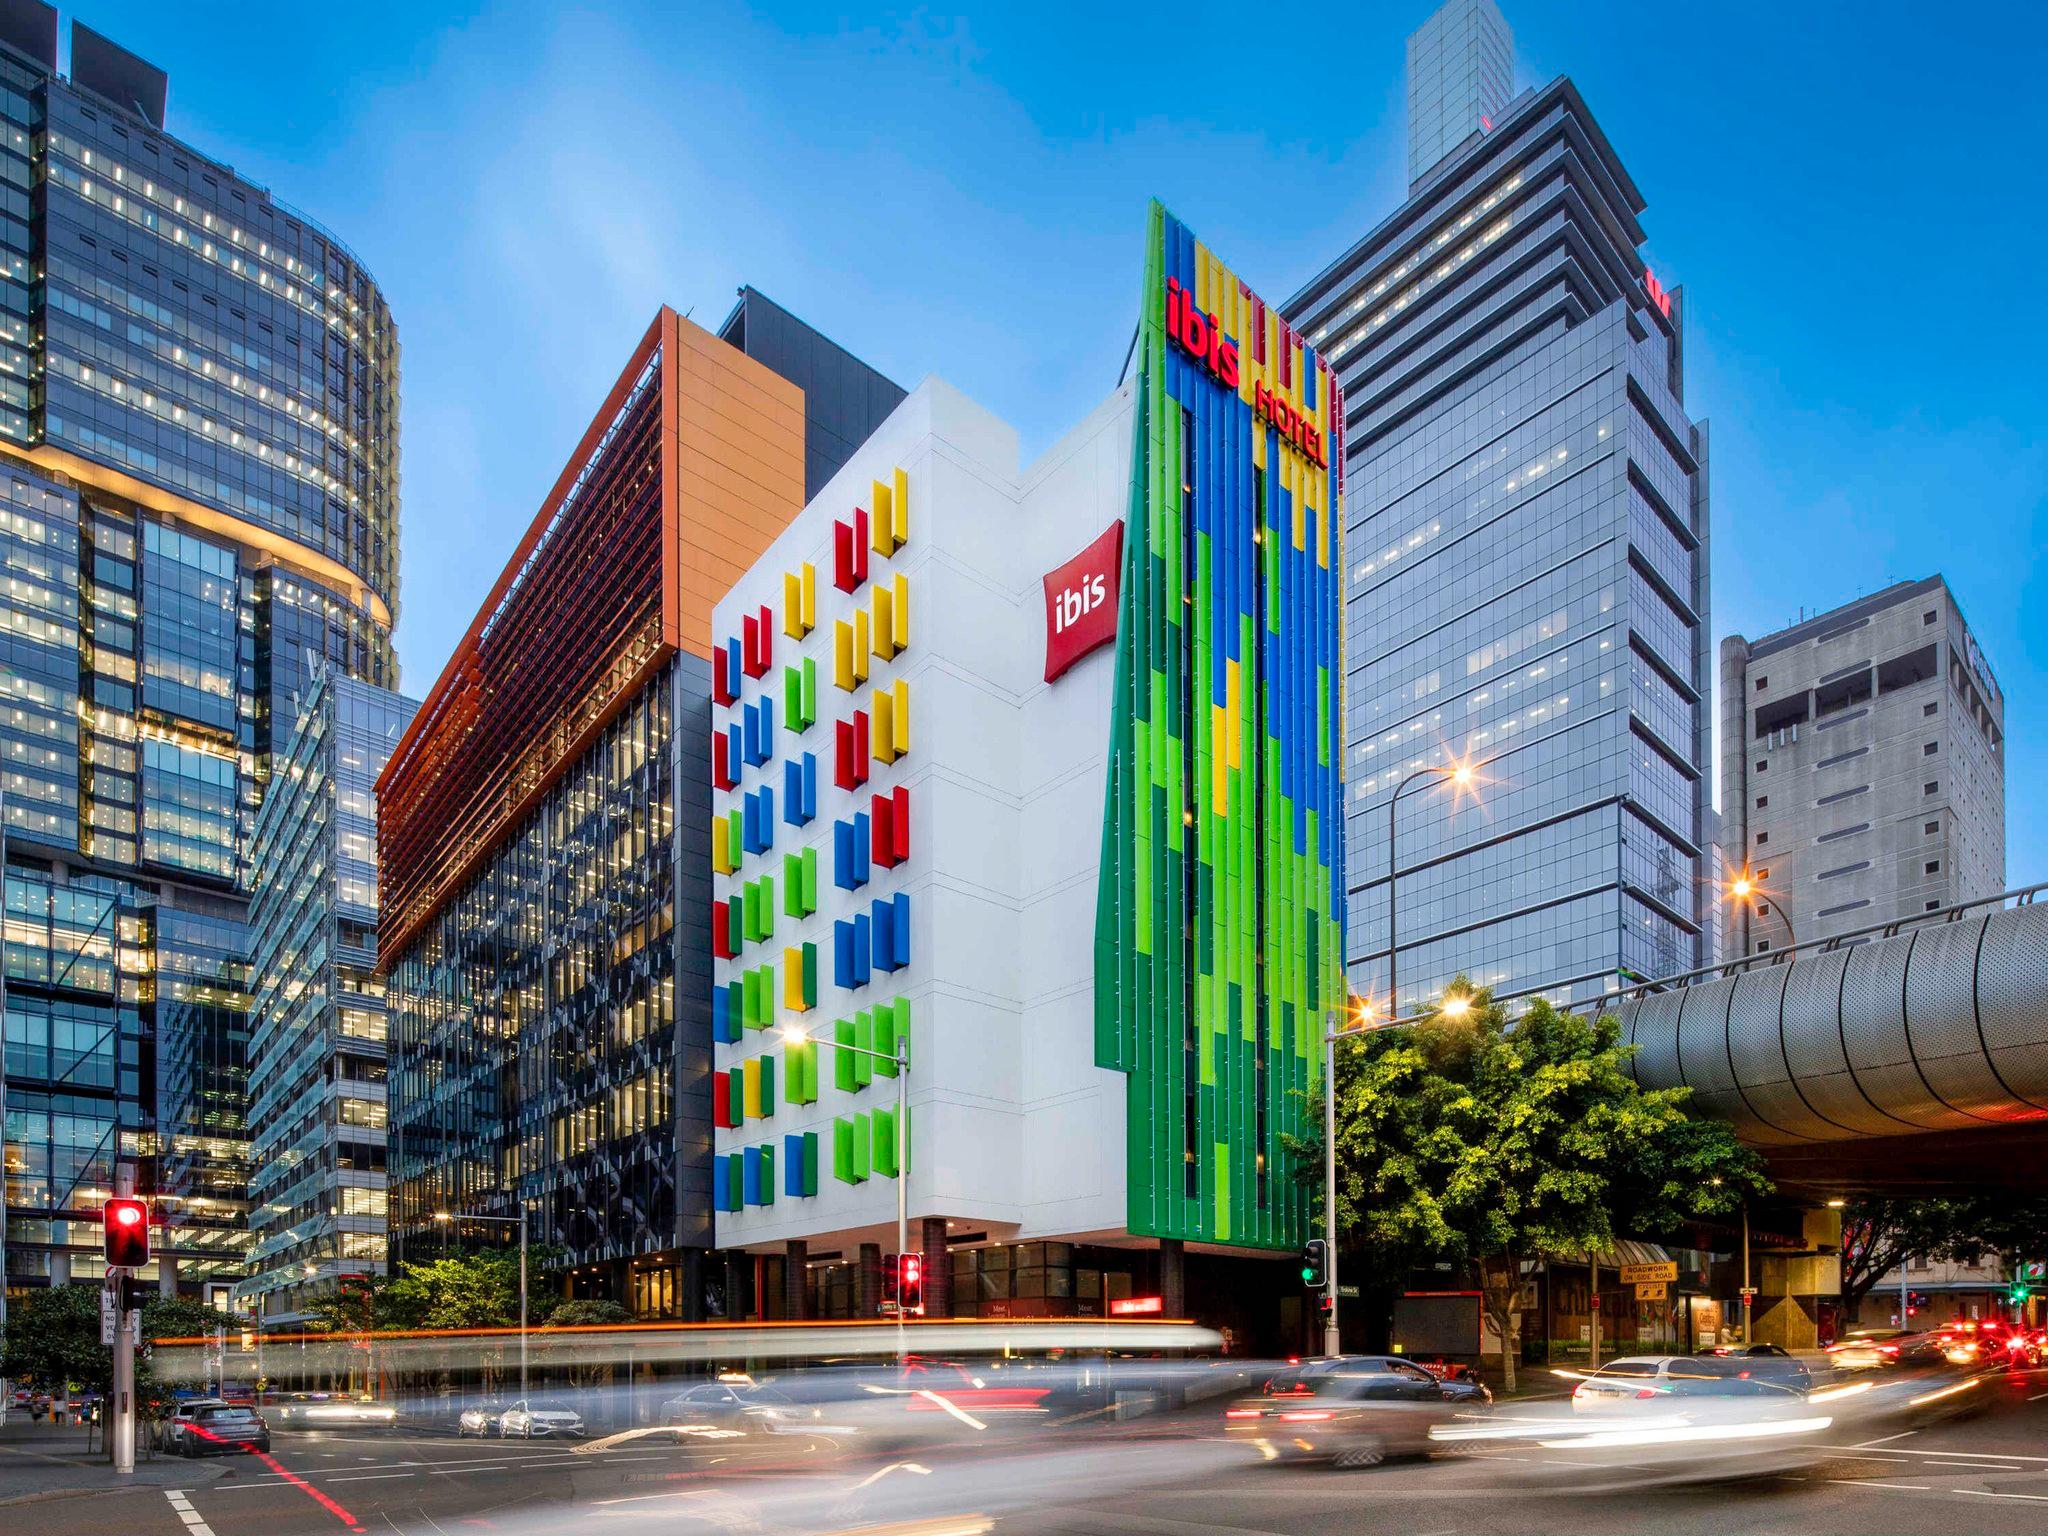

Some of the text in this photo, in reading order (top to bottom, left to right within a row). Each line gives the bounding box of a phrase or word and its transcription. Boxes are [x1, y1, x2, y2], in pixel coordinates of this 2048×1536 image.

[1167, 276, 1328, 471] ibis HOTEL
[1056, 573, 1106, 634] ibis
[1627, 1265, 1669, 1273] ROADWORK
